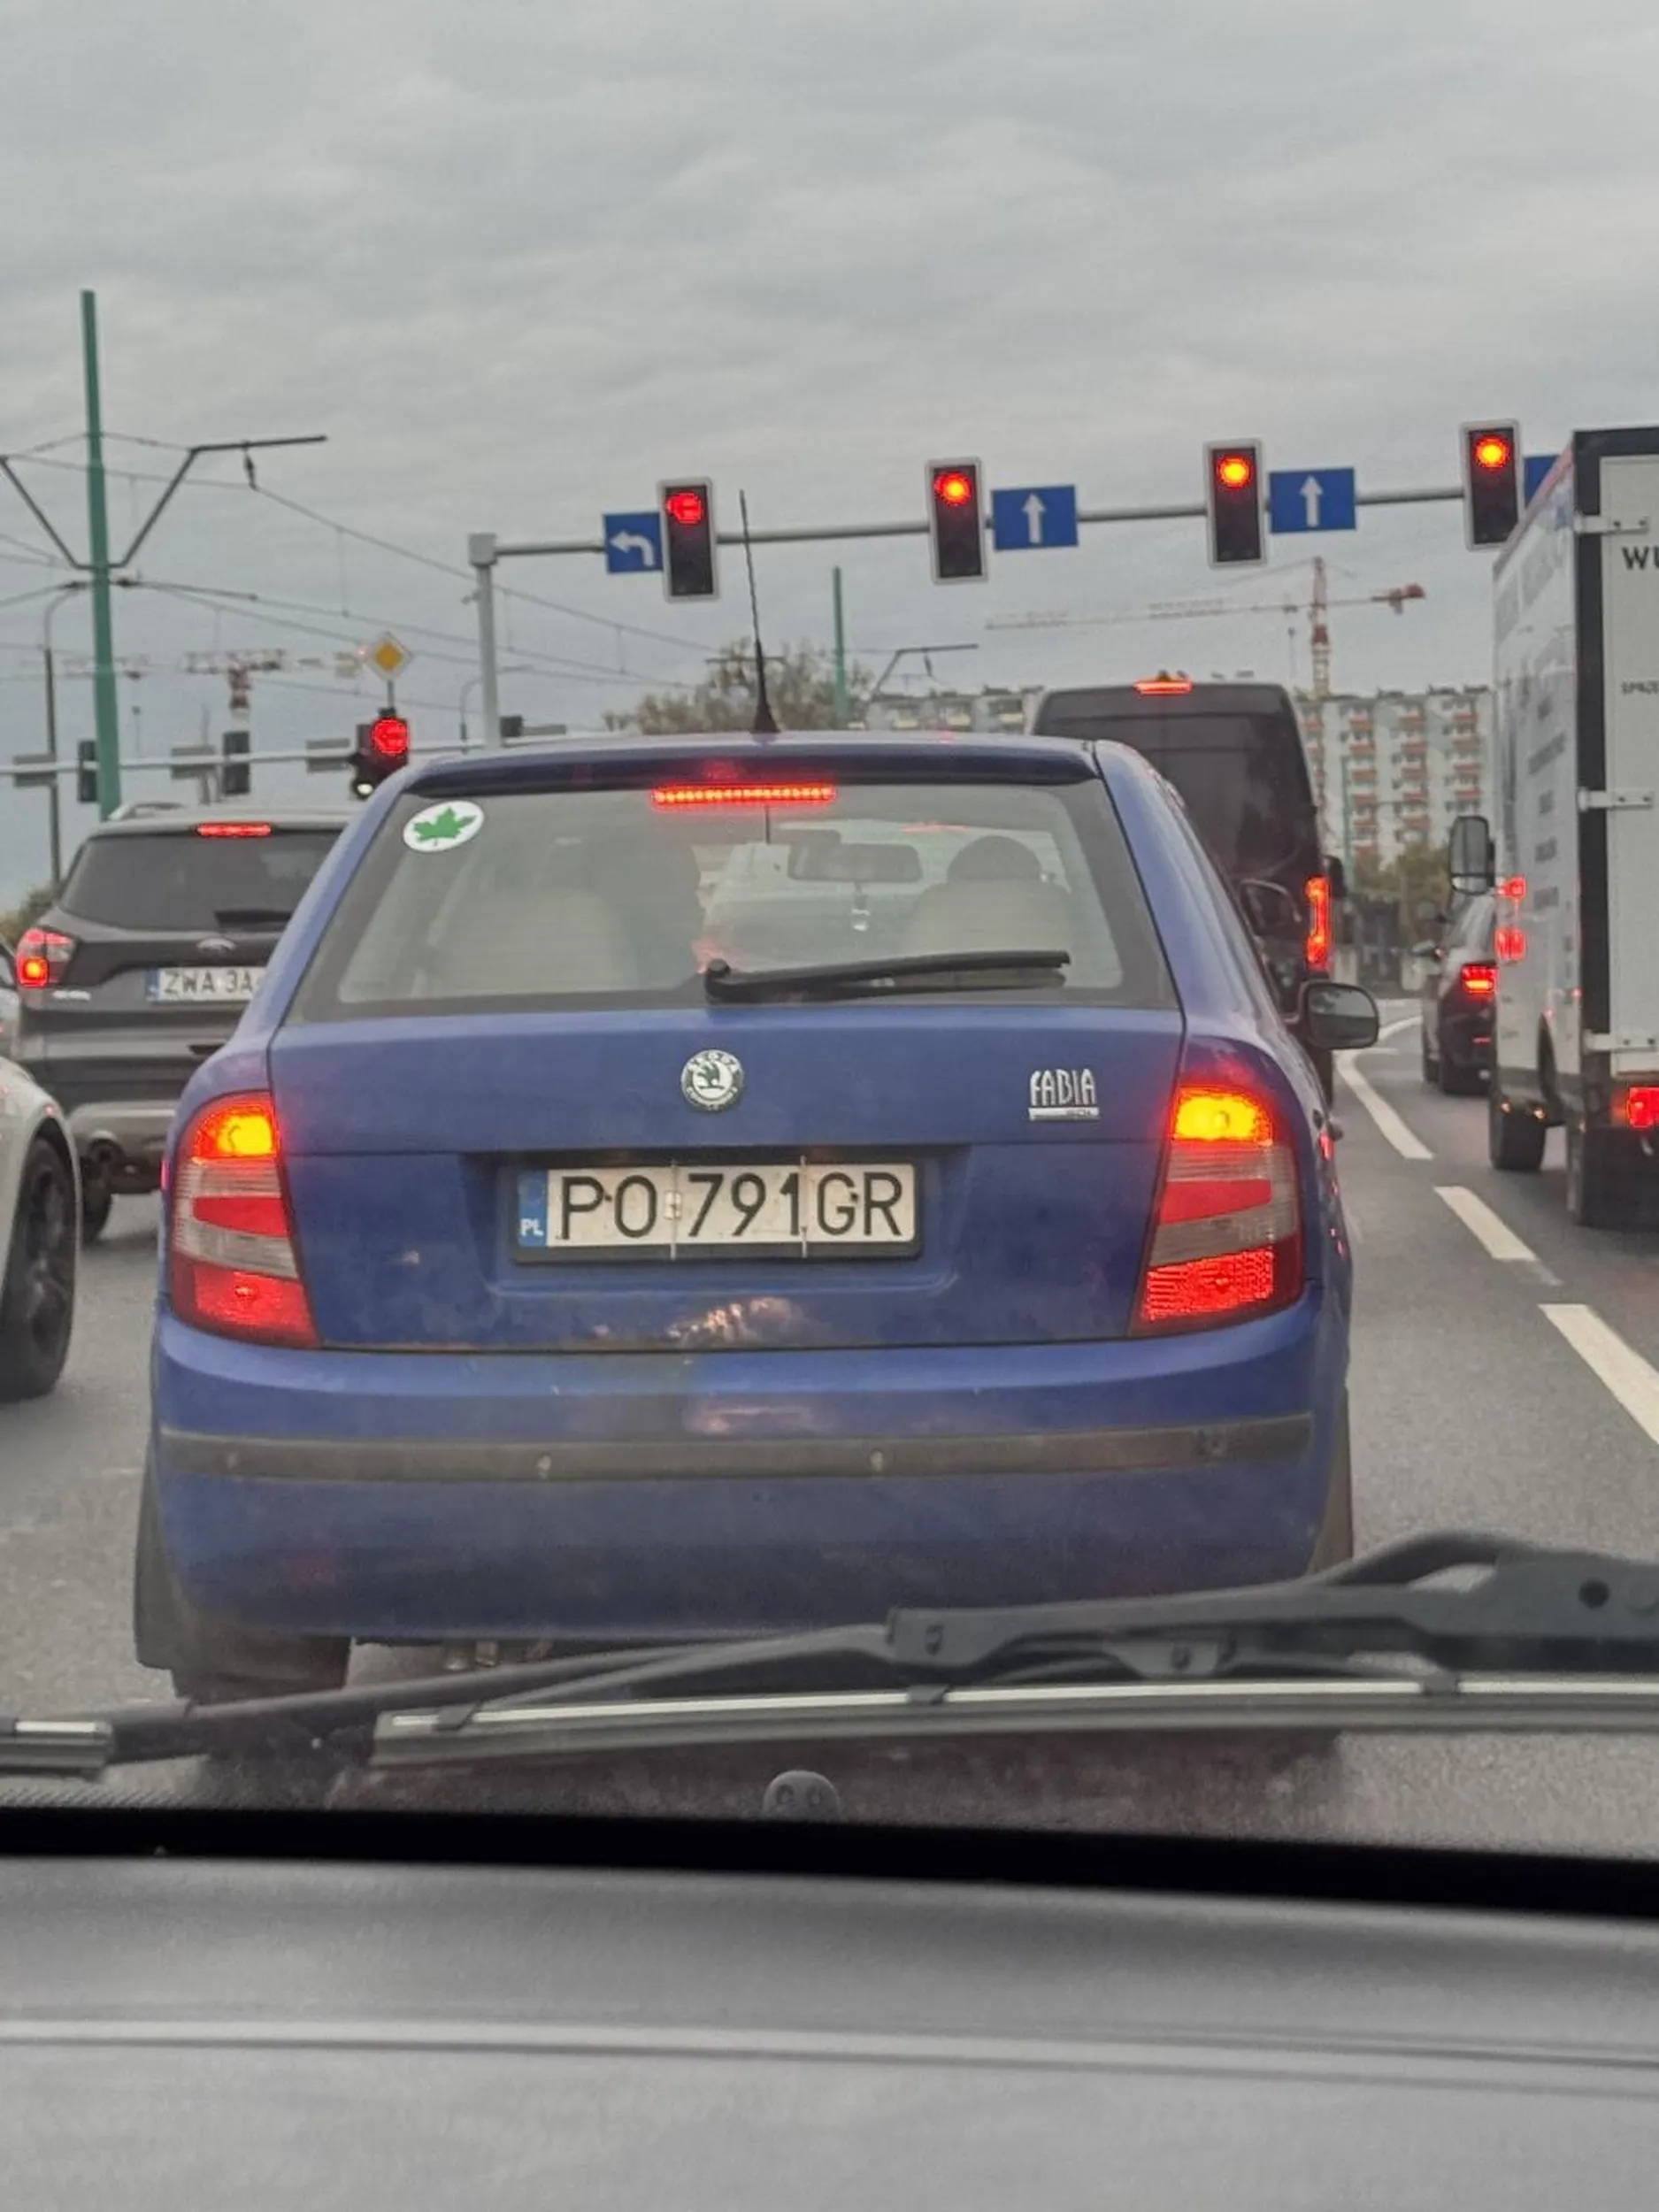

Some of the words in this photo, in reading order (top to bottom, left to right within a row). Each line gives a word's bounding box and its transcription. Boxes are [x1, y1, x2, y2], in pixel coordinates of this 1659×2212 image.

[1030, 1068, 1096, 1106] FABIA
[562, 1175, 657, 1240] PO
[687, 1171, 902, 1238] 791GR
